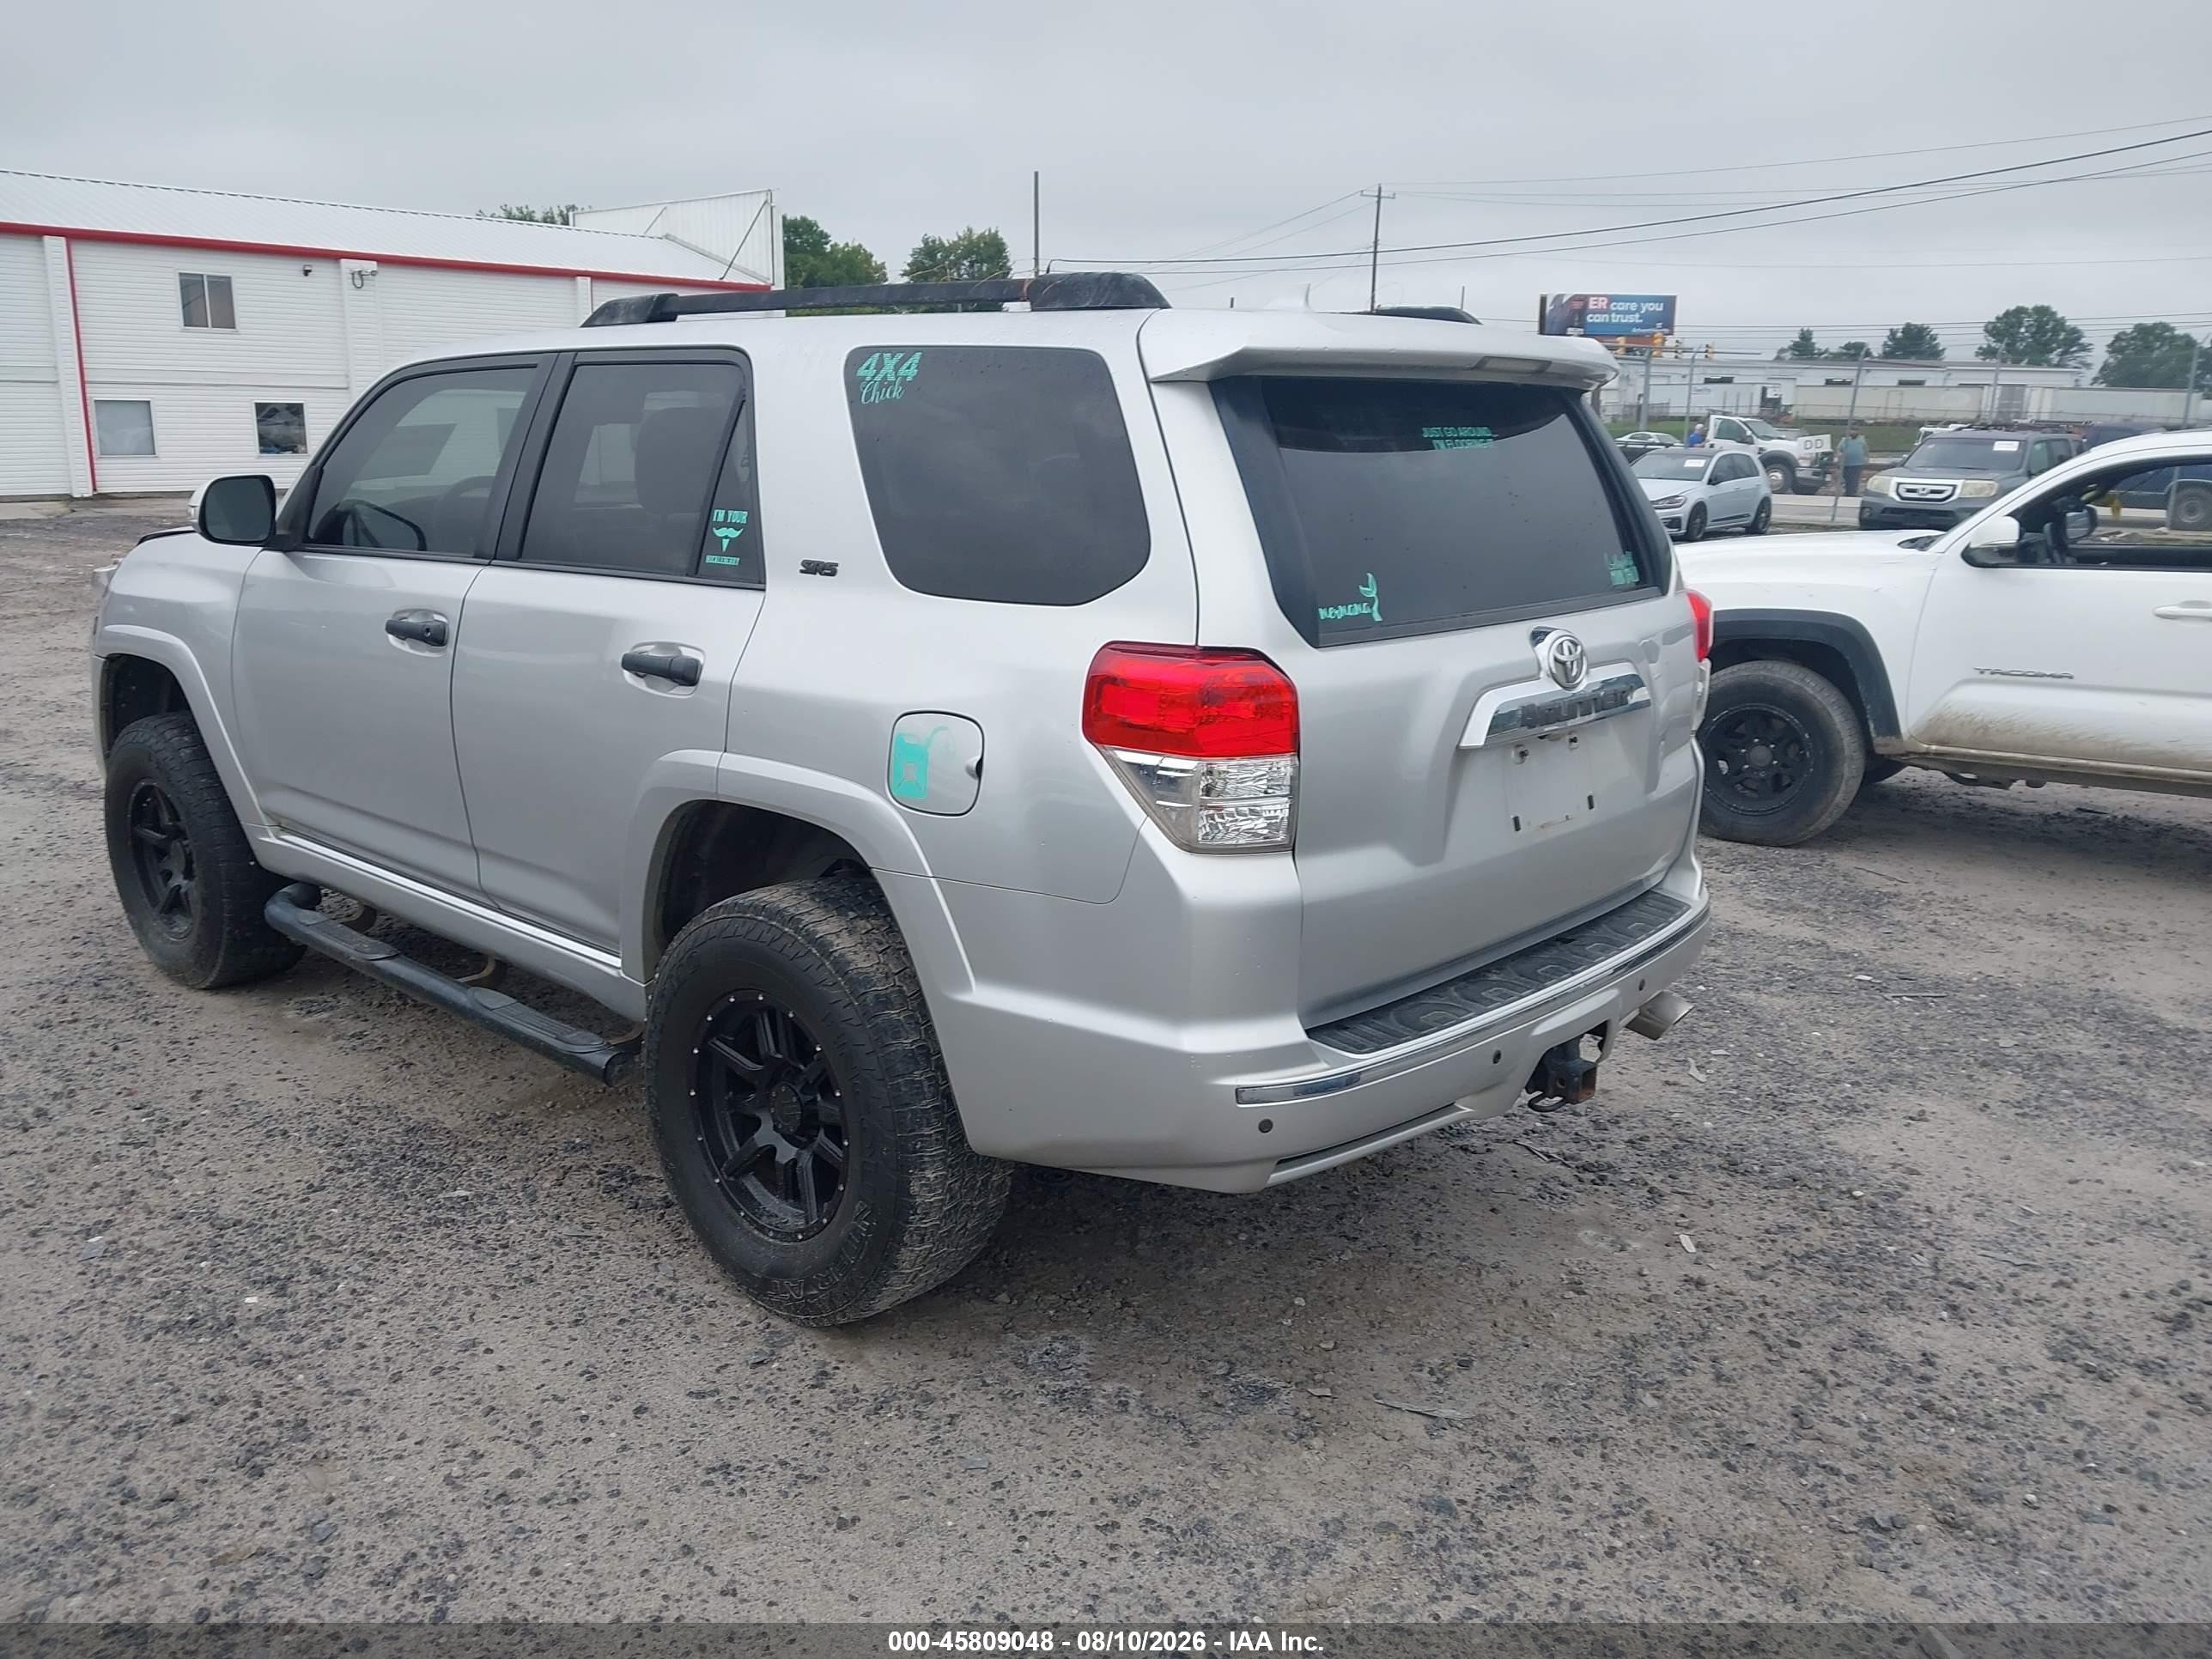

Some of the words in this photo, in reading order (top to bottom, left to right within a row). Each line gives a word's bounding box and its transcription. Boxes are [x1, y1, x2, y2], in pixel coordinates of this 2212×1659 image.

[1588, 296, 1608, 310] ER
[1610, 301, 1638, 311] care
[1639, 301, 1664, 313] you
[1587, 313, 1609, 323] can
[1611, 312, 1644, 323] trust.
[860, 376, 906, 404] Chick
